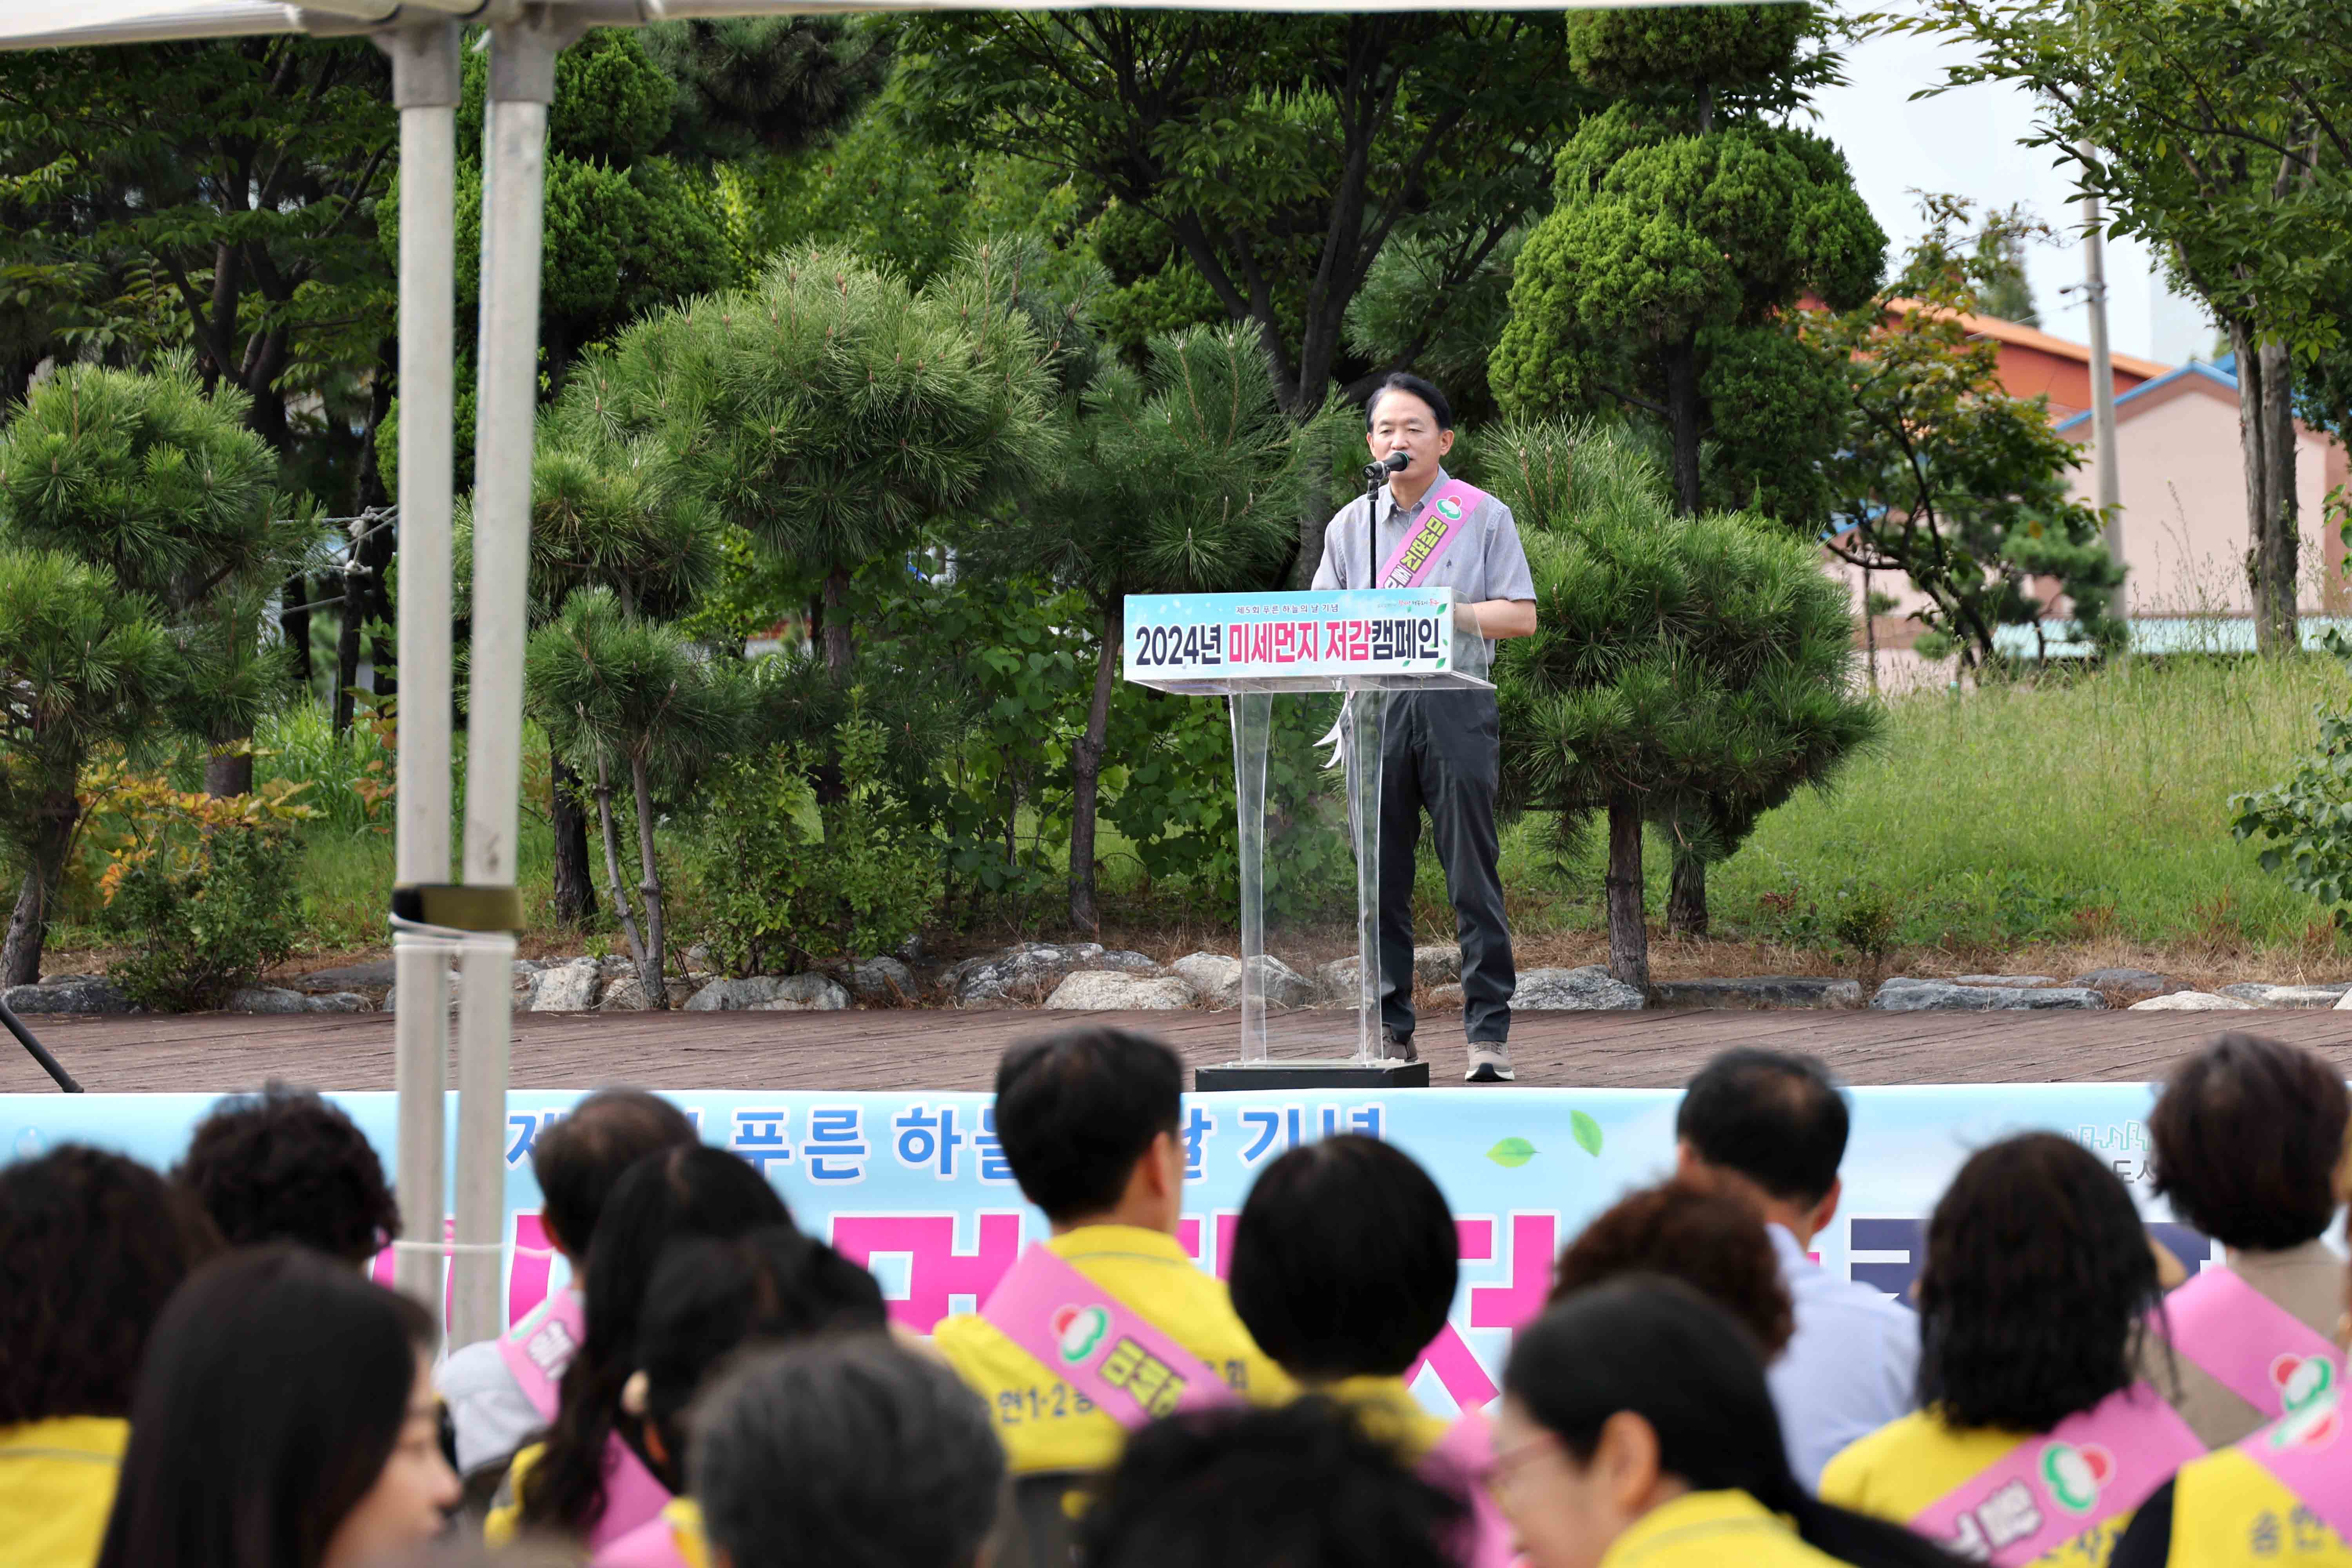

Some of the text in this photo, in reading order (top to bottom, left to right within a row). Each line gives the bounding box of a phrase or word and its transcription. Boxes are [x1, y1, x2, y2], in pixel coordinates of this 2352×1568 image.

[1399, 515, 1448, 574] 미세먼지
[1236, 603, 1339, 614] 제5회 푸른 하늘의 날 기념
[1136, 618, 1439, 665] 2024년 미세먼지 저감캠페인
[735, 1109, 865, 1180] 푸른
